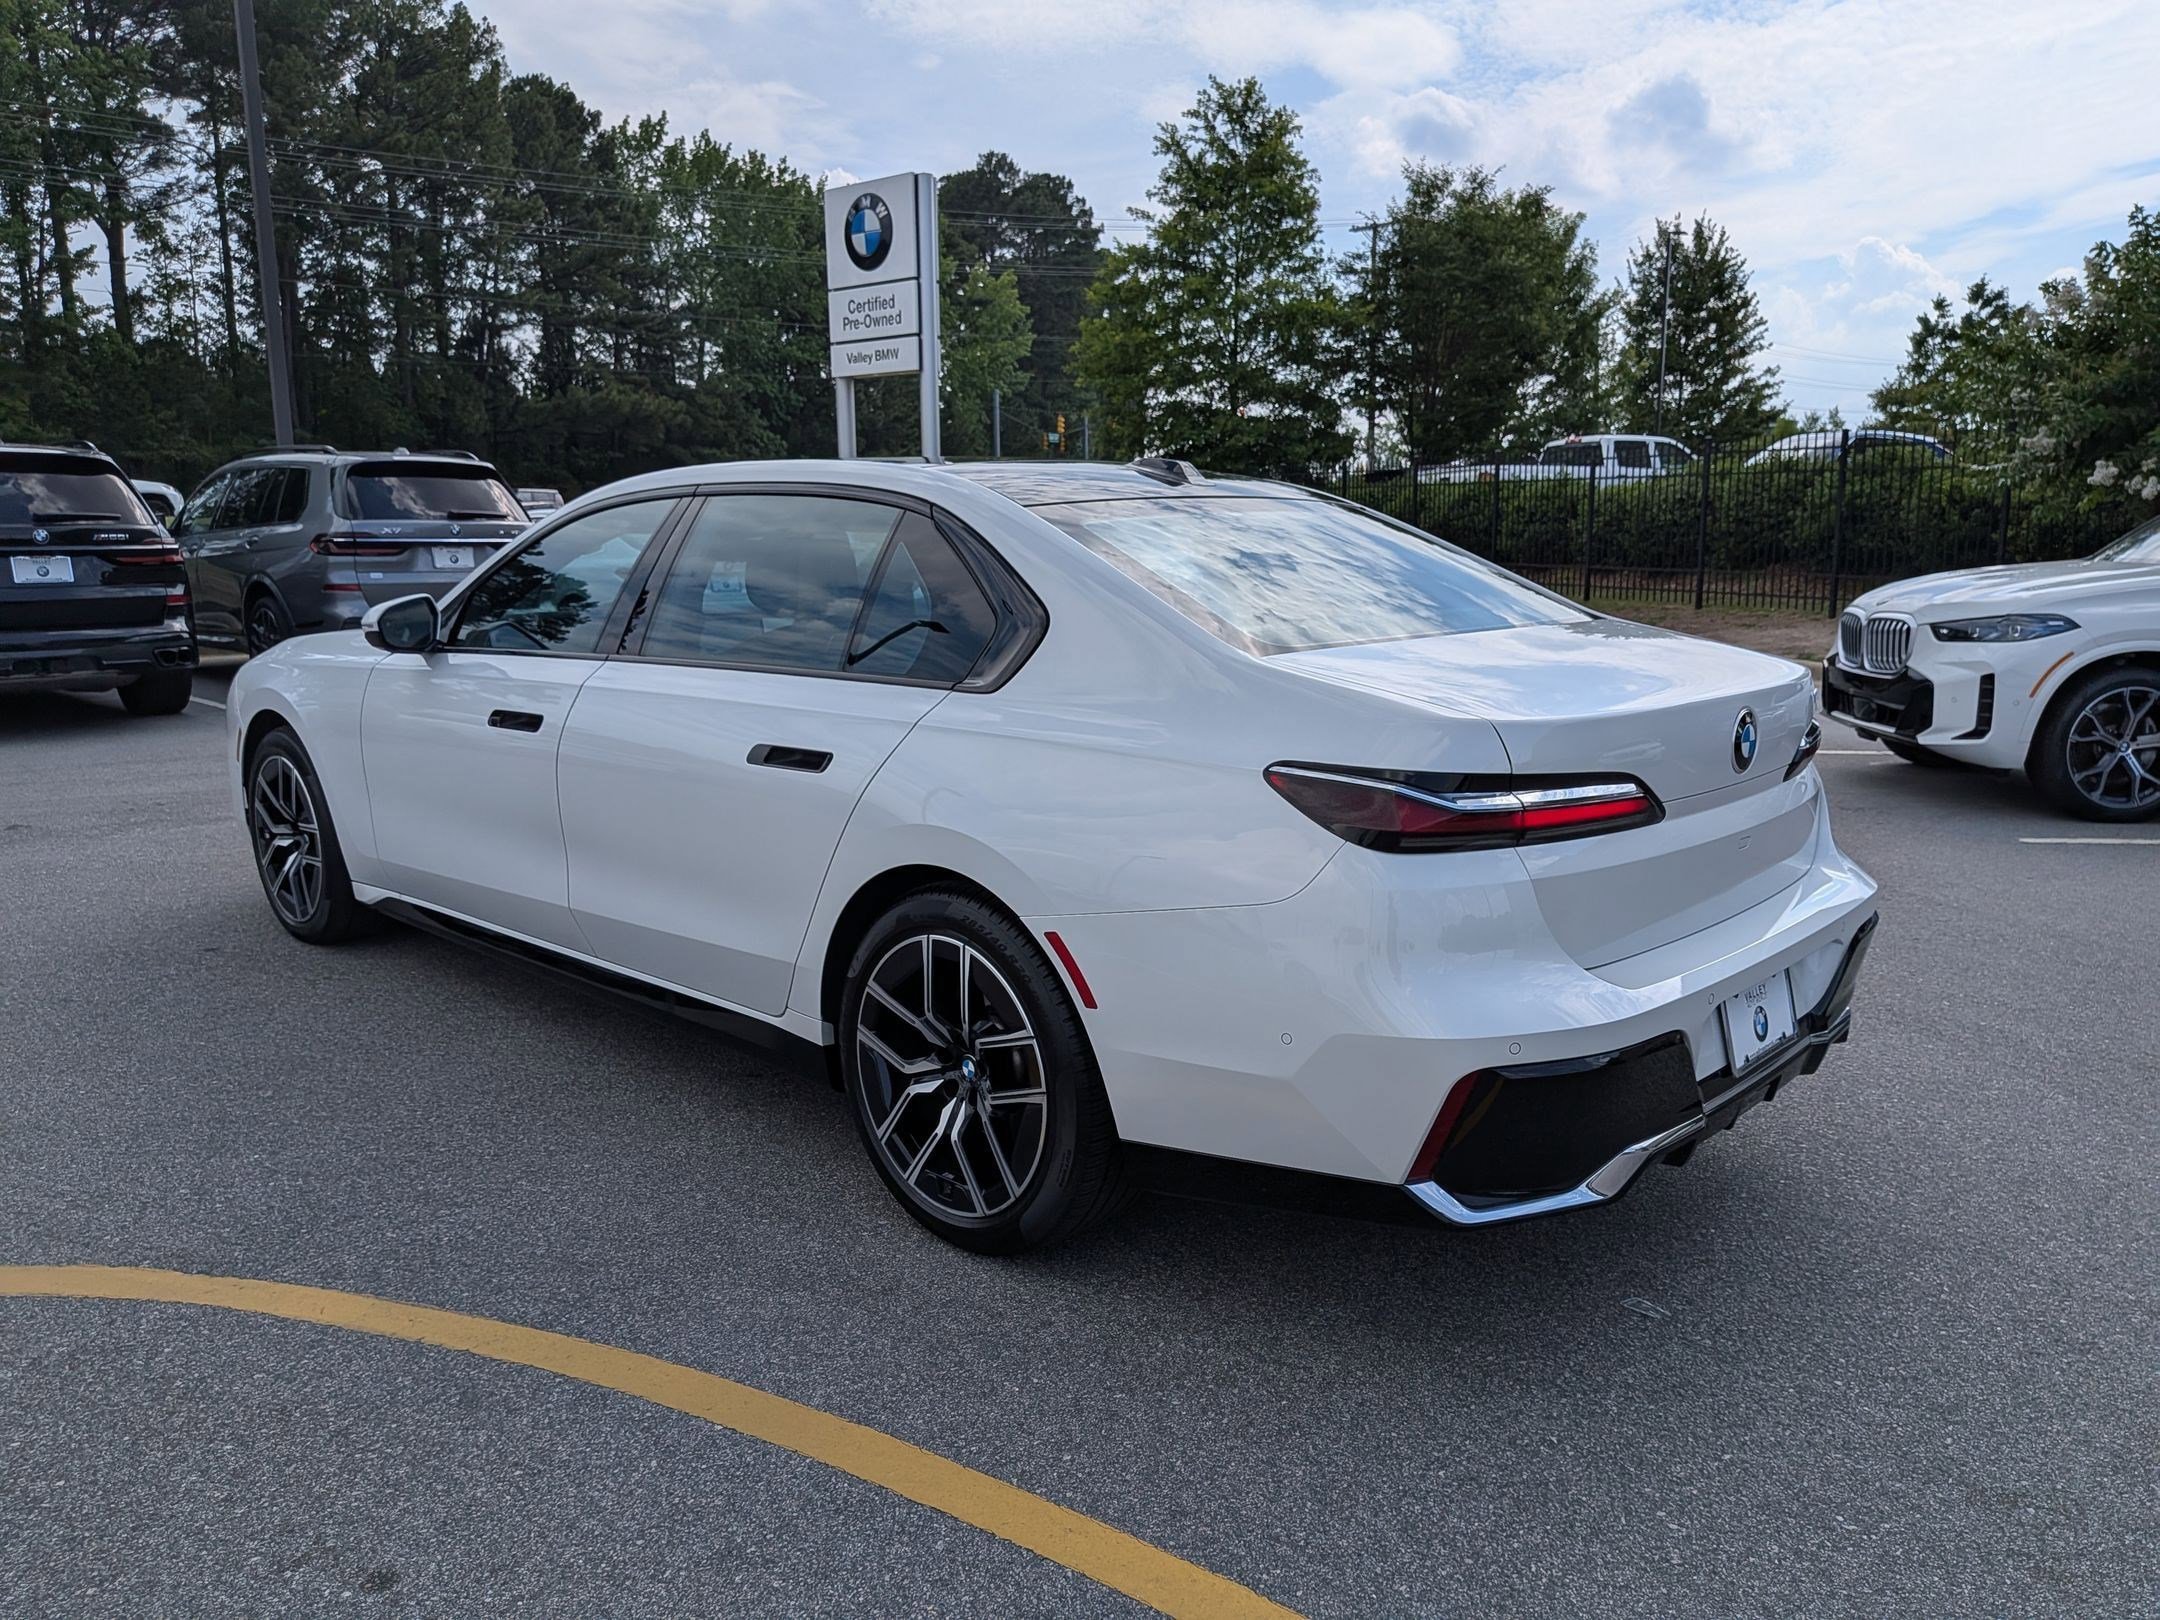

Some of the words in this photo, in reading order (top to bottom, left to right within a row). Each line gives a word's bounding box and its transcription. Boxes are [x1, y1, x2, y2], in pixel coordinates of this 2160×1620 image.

[847, 294, 896, 314] Certified
[842, 311, 902, 331] Pre-Owned
[846, 351, 873, 365] Valley
[874, 348, 900, 362] BMW
[1744, 984, 1767, 1002] VALLEY
